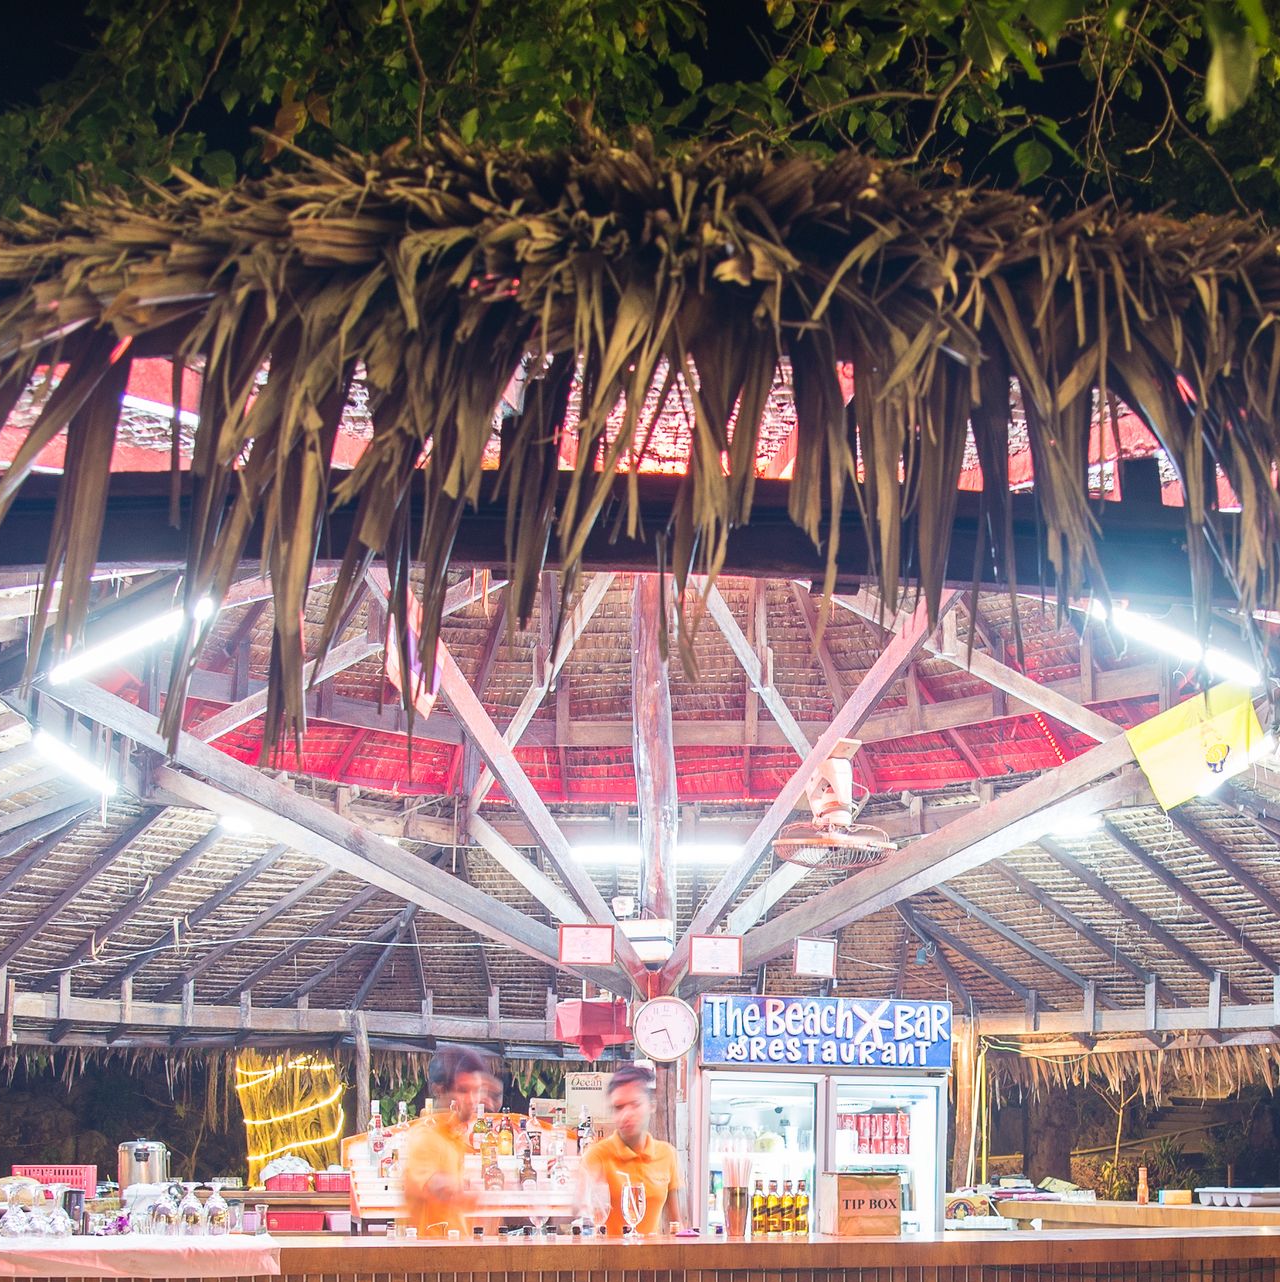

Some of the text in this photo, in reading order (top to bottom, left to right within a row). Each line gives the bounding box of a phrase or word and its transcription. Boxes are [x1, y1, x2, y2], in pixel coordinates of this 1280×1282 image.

[705, 998, 761, 1037] The
[765, 999, 856, 1039] Beach
[571, 1077, 602, 1087] Ocean
[842, 1199, 897, 1210] TIP BOX
